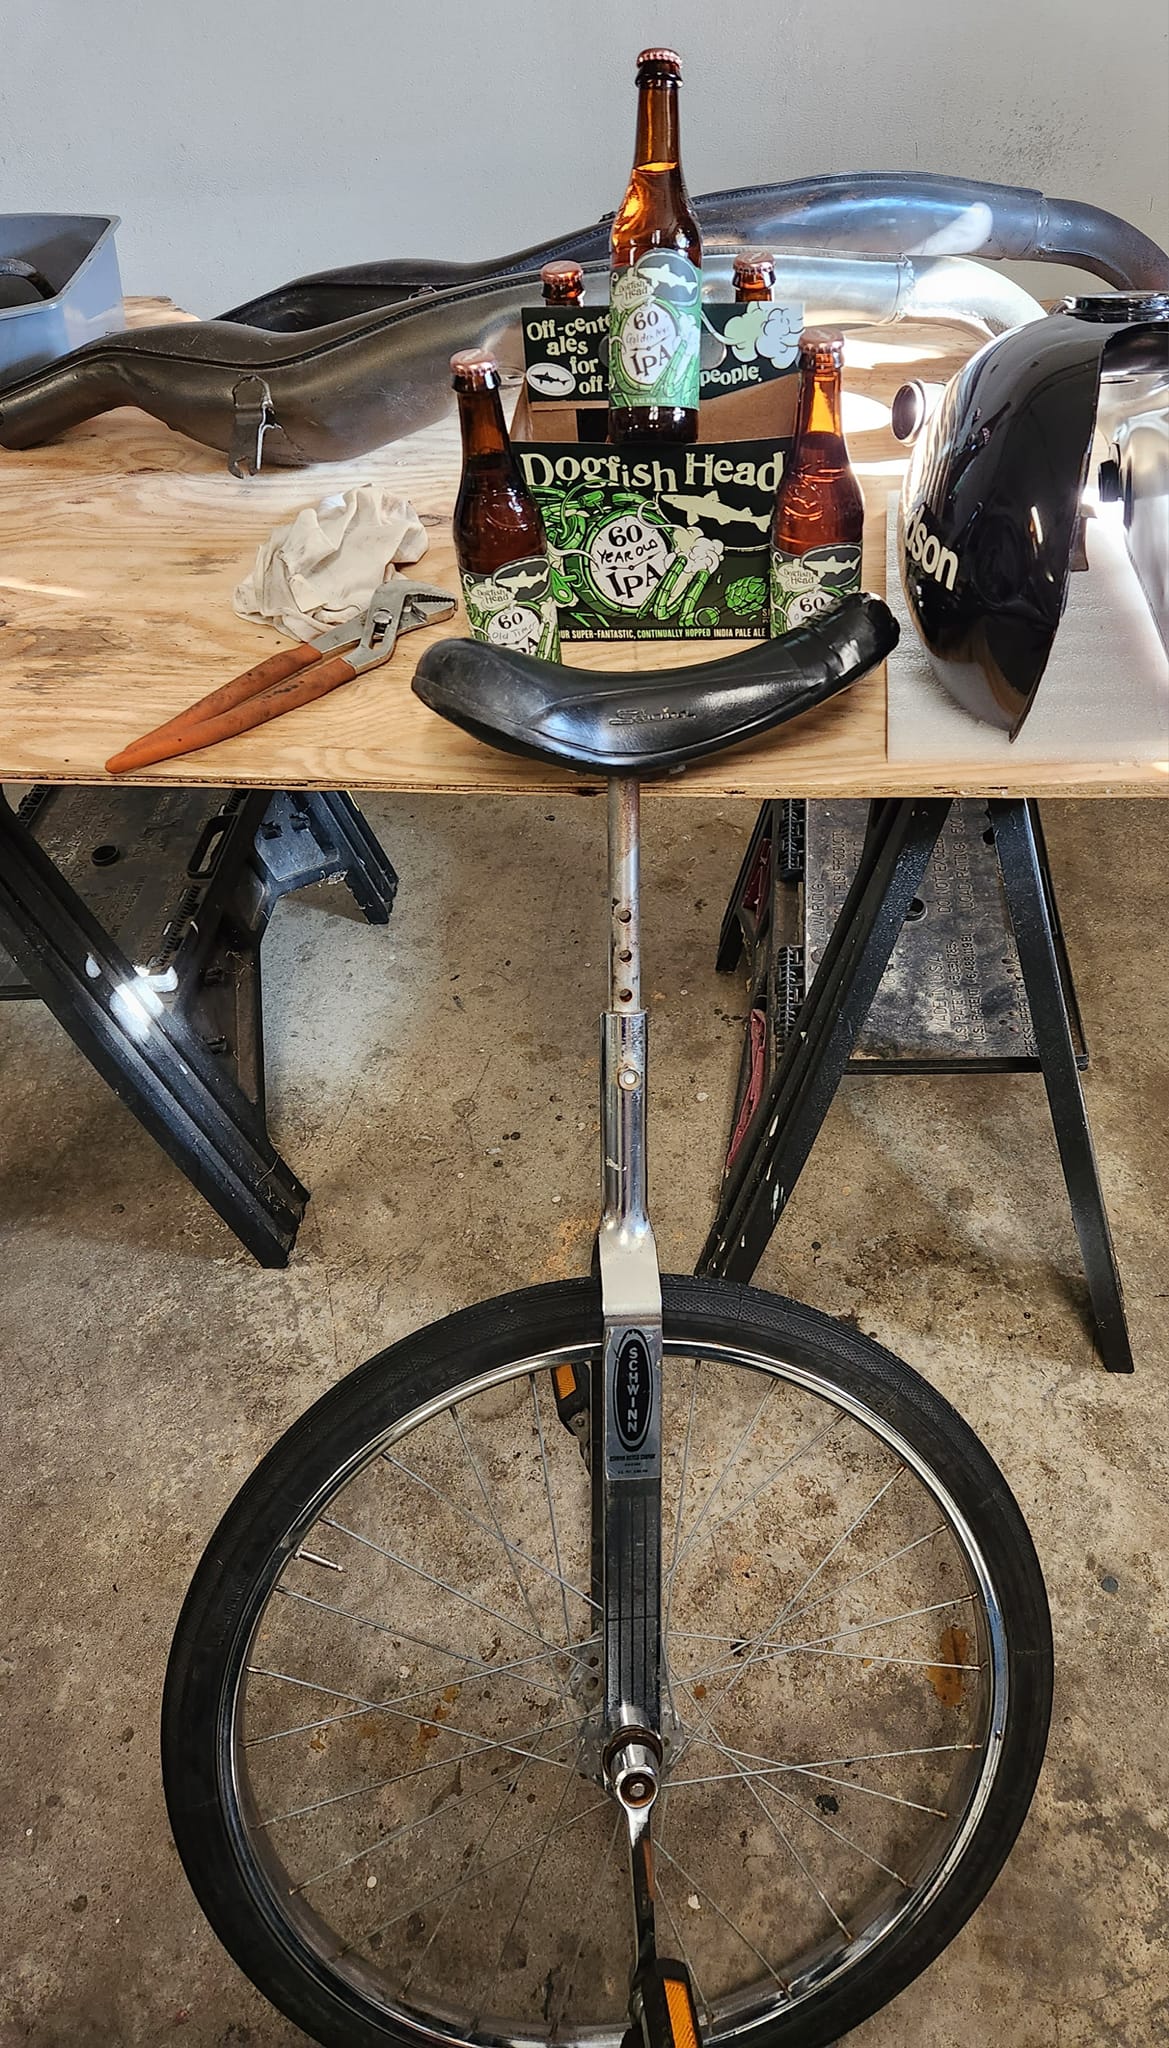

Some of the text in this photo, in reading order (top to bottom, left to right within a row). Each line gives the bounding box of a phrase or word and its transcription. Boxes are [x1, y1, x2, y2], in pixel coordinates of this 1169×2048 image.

[526, 313, 611, 341] Off-cente
[633, 310, 659, 331] 60
[546, 335, 588, 356] ales
[569, 355, 599, 375] for
[630, 345, 672, 377] IPA
[578, 364, 762, 395] off- people.
[520, 451, 784, 492] Dogfish Head
[608, 524, 643, 547] 60
[904, 503, 959, 592] dson
[605, 563, 663, 599] IPA
[790, 576, 815, 586] Head
[485, 593, 509, 605] Head
[799, 596, 825, 613] 60
[498, 612, 524, 630] 60
[571, 629, 637, 640] SUPER-FANTASTIC,
[636, 628, 684, 639] CONTINUALLY
[684, 628, 711, 638] HOPPED
[713, 628, 734, 638] INDIA
[735, 627, 752, 638] PALE
[752, 627, 767, 637] ALE
[626, 1346, 640, 1433] SCHWINN
